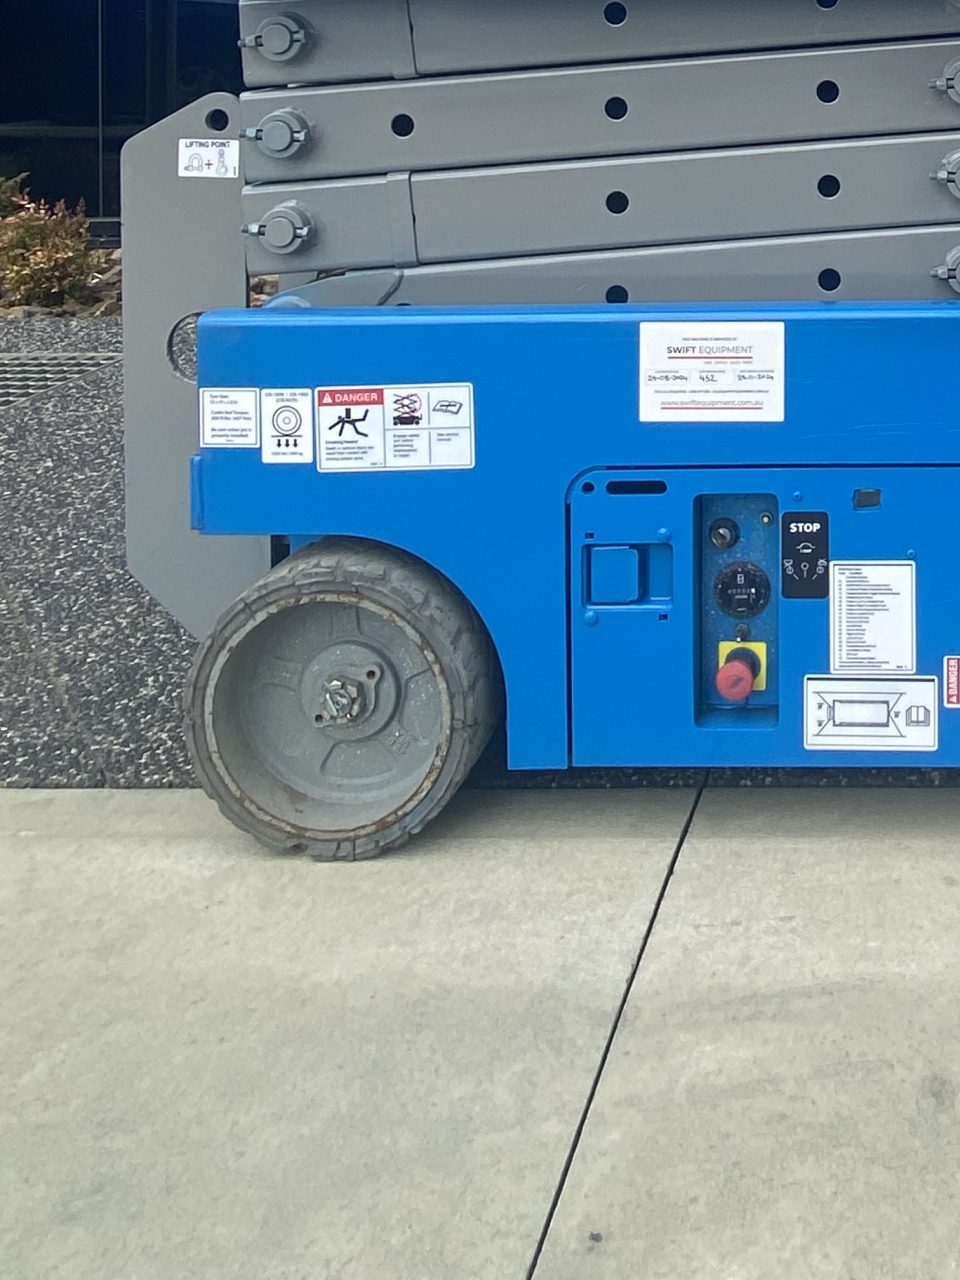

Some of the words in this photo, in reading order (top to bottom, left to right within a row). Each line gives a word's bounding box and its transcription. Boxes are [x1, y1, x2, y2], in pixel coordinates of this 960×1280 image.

[667, 346, 696, 354] SWIFT
[698, 346, 753, 355] EQUIPMENT
[335, 392, 378, 402] DANGER
[789, 522, 821, 533] STOP
[948, 659, 958, 695] DANGER
